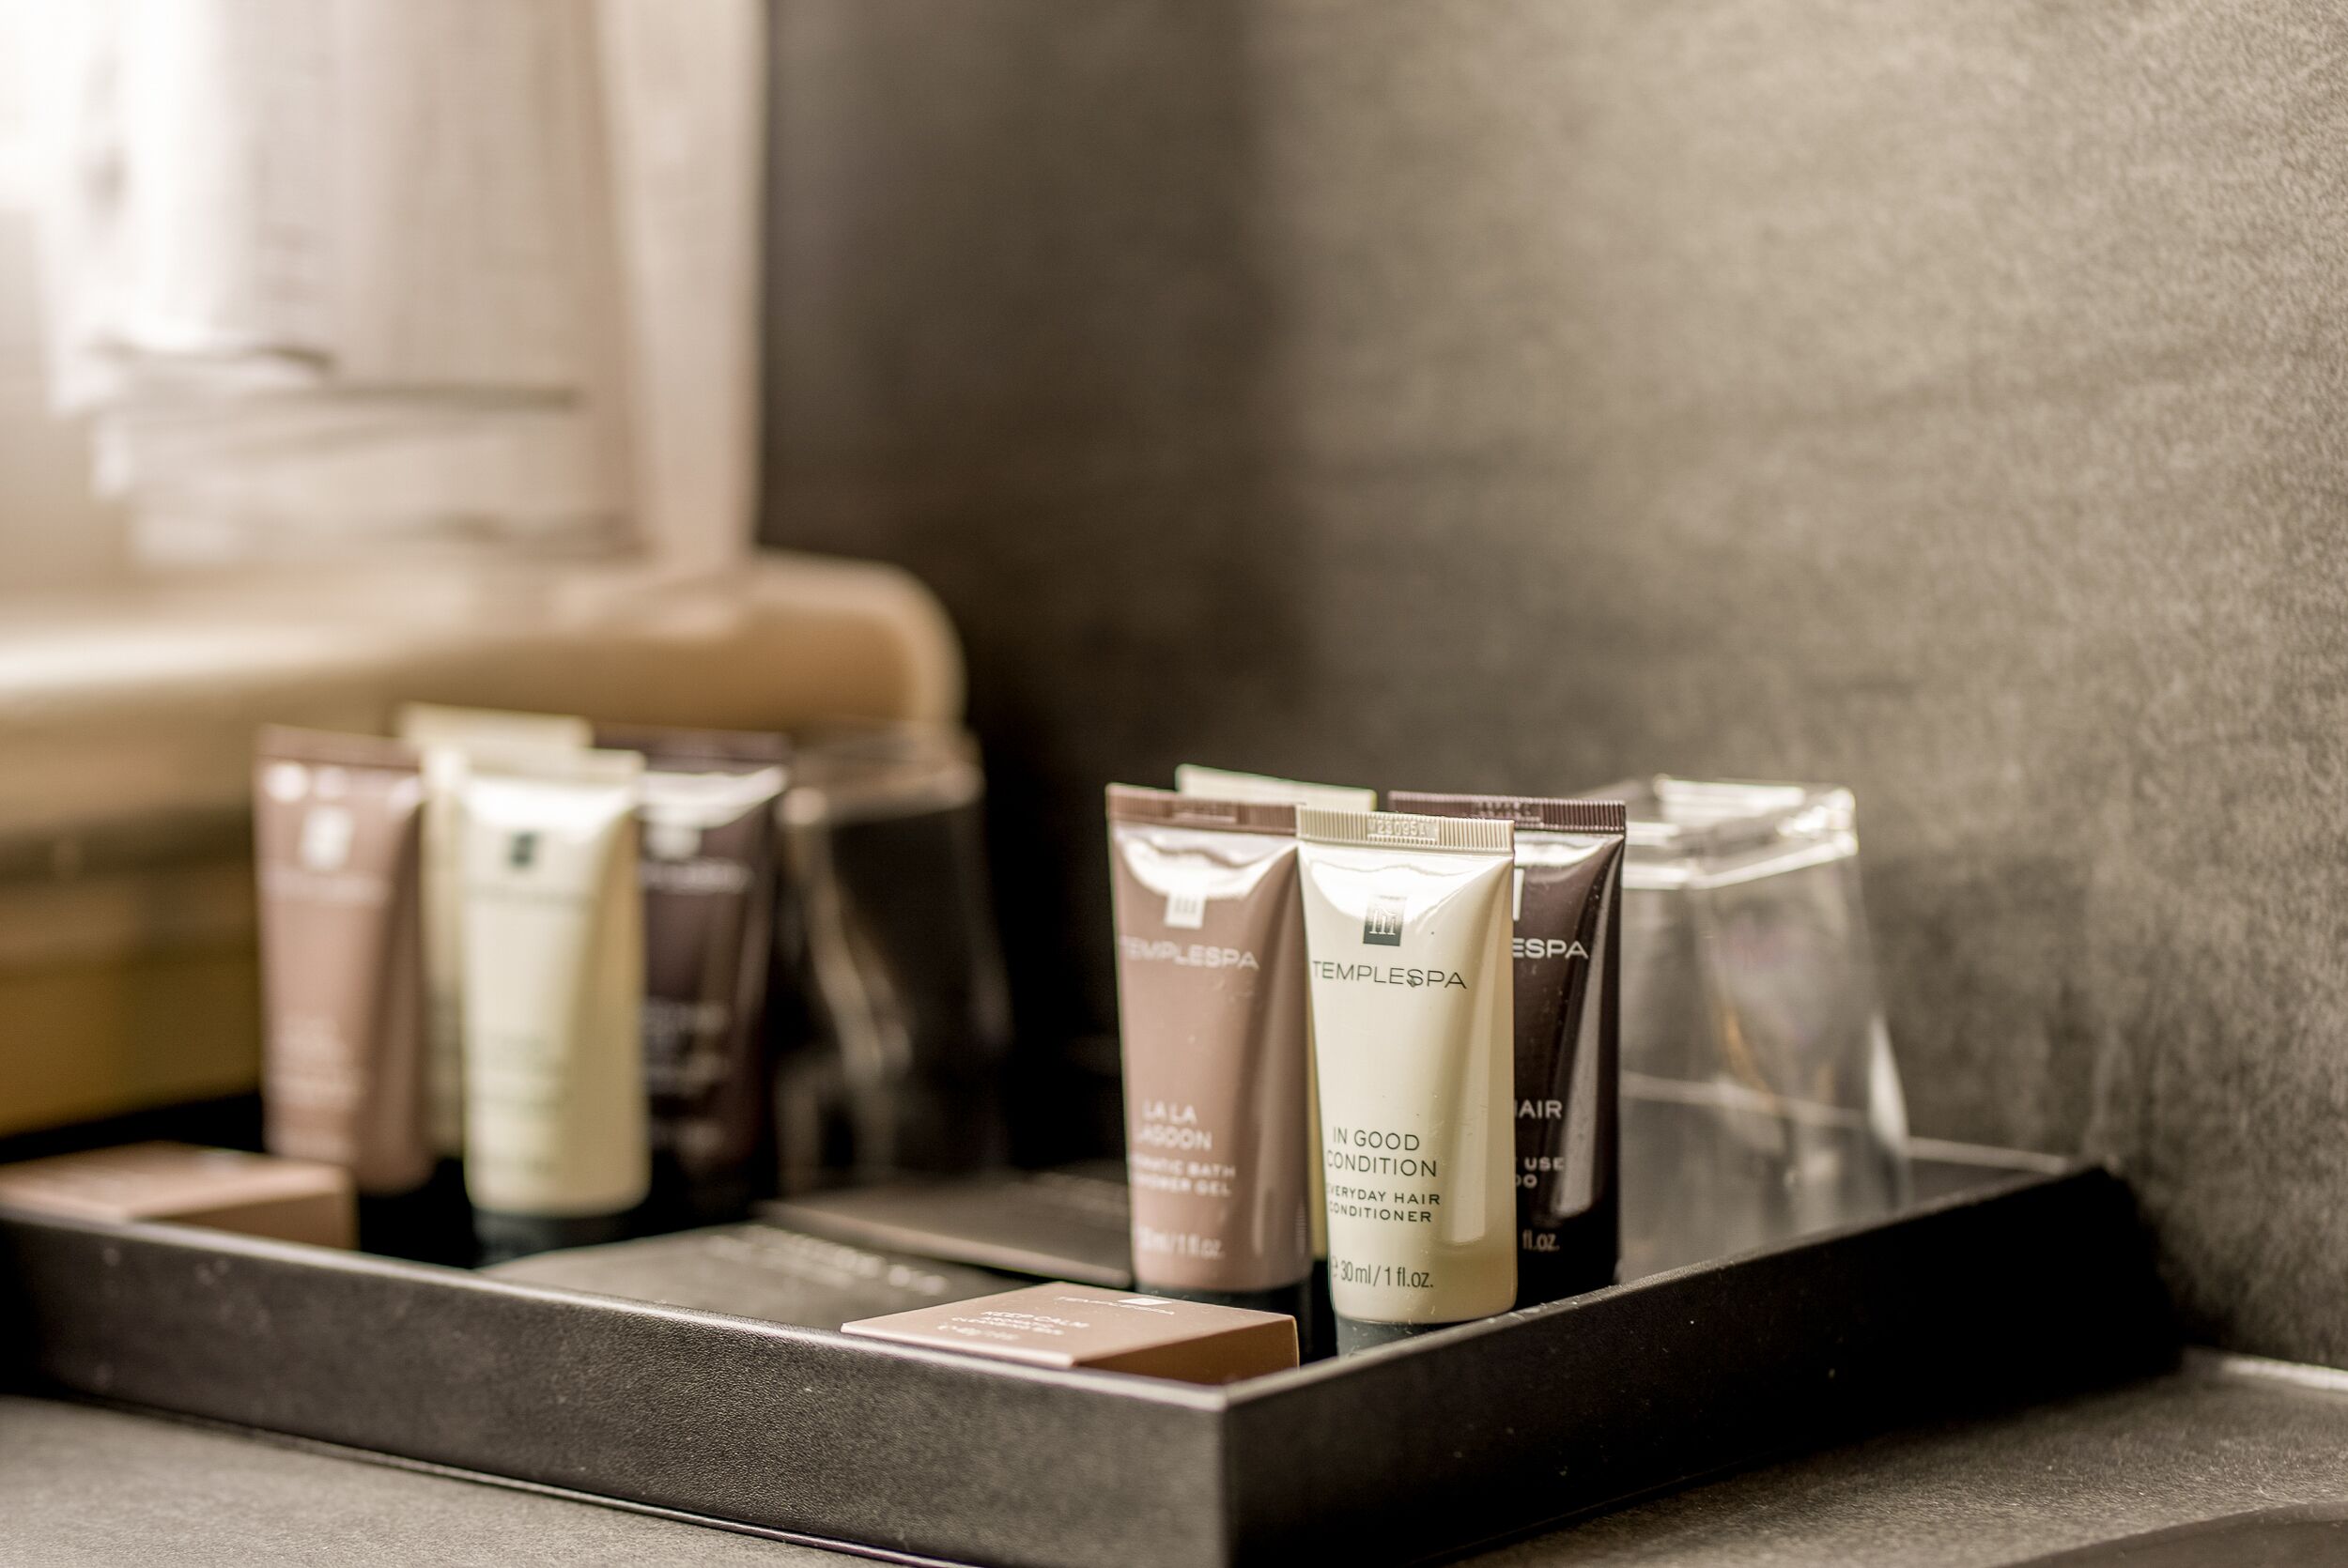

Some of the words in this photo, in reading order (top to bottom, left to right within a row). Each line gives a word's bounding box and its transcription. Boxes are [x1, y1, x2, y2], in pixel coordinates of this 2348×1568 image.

[1312, 961, 1467, 990] TEMPLESPA
[1142, 1099, 1166, 1121] LA
[1169, 1102, 1197, 1126] LA
[1333, 1126, 1348, 1145] IN
[1353, 1130, 1420, 1151] GOOD
[1186, 1161, 1236, 1178] BATH
[1327, 1149, 1437, 1177] CONDITION
[1523, 1156, 1565, 1171] USE
[1194, 1178, 1232, 1196] GEL
[1394, 1192, 1441, 1206] HAIR
[1329, 1199, 1432, 1222] CONDITIONER
[1397, 1266, 1434, 1288] fl.oz.
